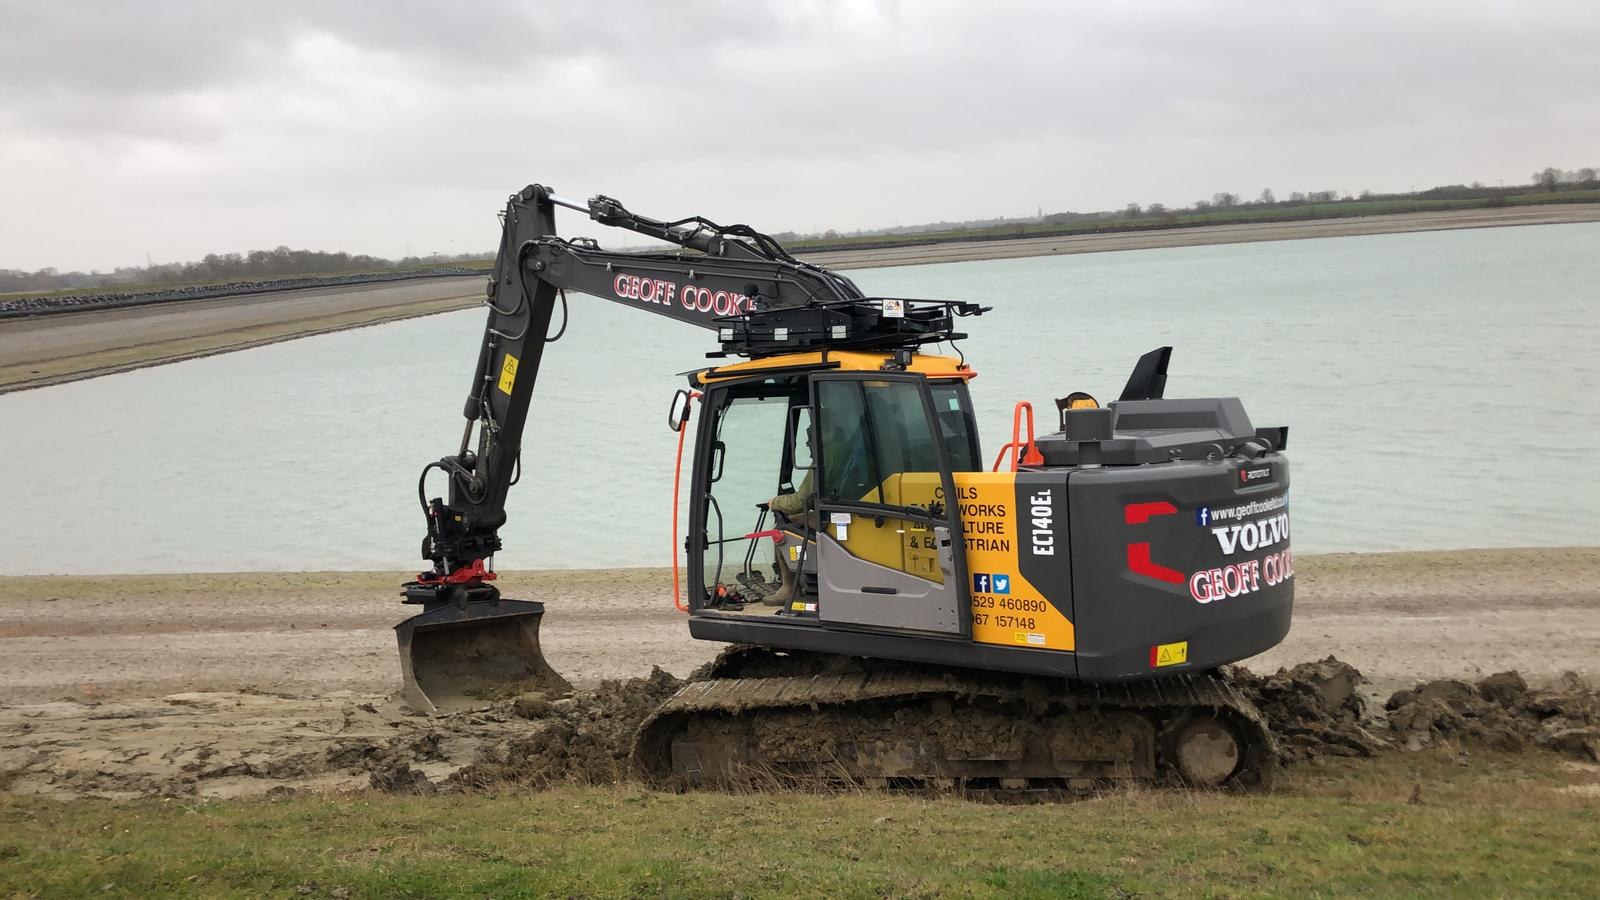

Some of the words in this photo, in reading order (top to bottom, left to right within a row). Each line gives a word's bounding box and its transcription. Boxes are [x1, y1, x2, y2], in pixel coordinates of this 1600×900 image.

[613, 273, 676, 306] GEOFF
[1211, 513, 1289, 555] VOLVO
[1189, 560, 1260, 604] GEOFF
[999, 598, 1047, 613] 460890
[994, 615, 1036, 630] 157148
